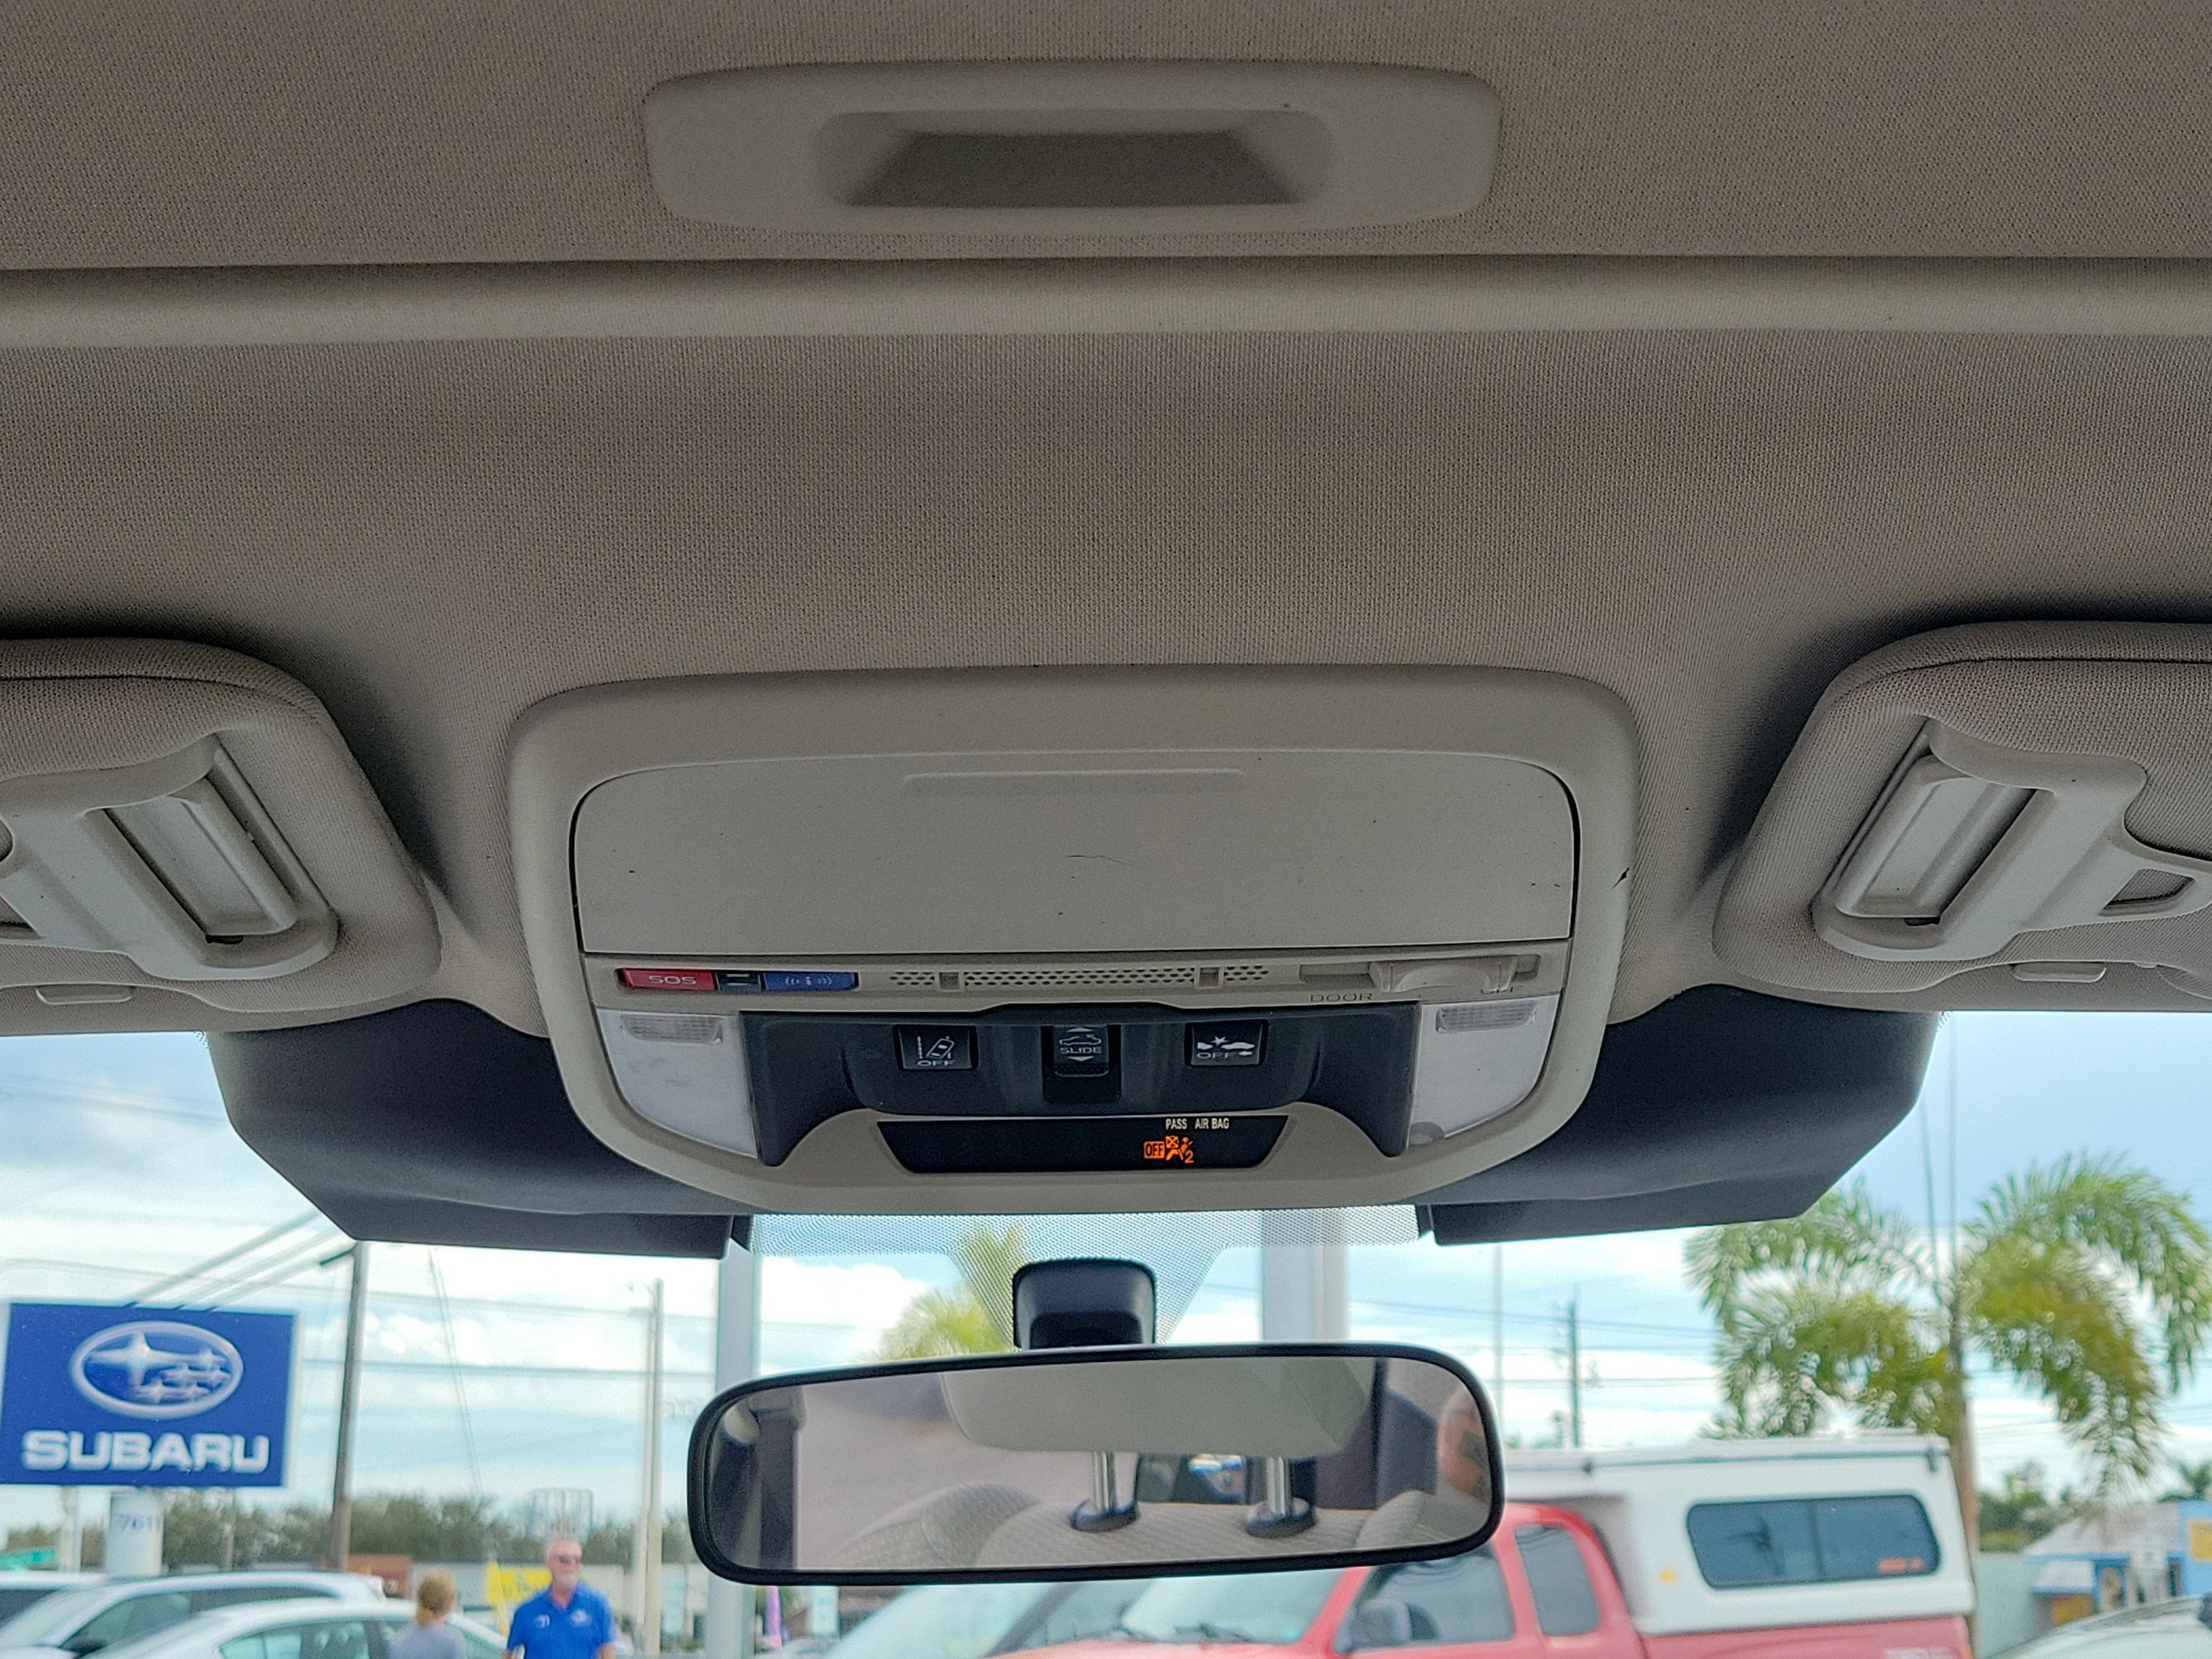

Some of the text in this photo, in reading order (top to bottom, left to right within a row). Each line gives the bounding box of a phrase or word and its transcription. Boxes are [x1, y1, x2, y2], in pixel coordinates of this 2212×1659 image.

[648, 975, 697, 985] SOS
[1311, 993, 1373, 1002] DOOR
[1059, 1046, 1102, 1054] SLIDE
[1165, 1118, 1229, 1130] PASS AIR BAG
[1144, 1142, 1164, 1158] OFF
[22, 1430, 269, 1474] SUBARU
